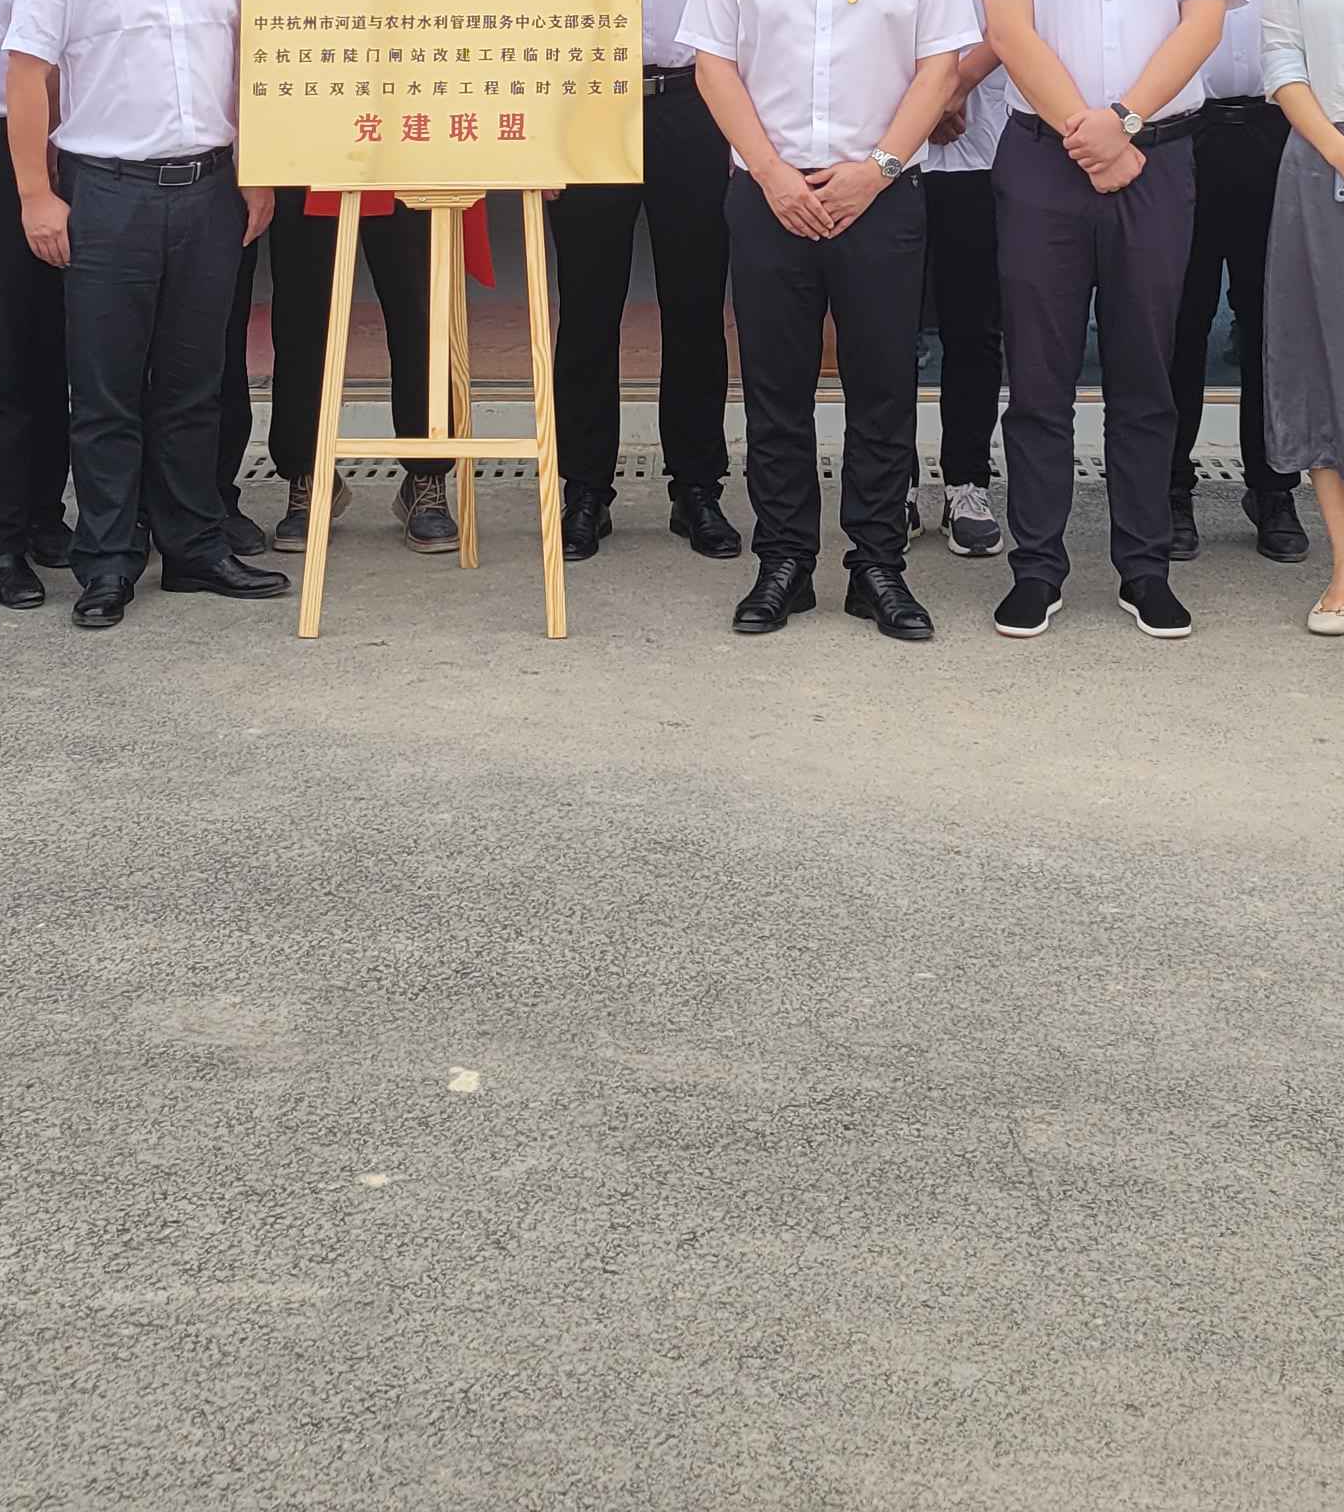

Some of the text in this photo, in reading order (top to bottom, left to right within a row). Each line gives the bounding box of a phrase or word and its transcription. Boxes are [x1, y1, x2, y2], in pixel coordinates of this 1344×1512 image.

[254, 14, 629, 32] 中共杭州市河道与农村水利管理服务中心支部委员会
[253, 47, 629, 64] 余杭区新陡门闸站改建工程临时党支部
[252, 80, 629, 97] 临安区双溪口水库工程临时党支部
[353, 112, 527, 143] 党建联盟
